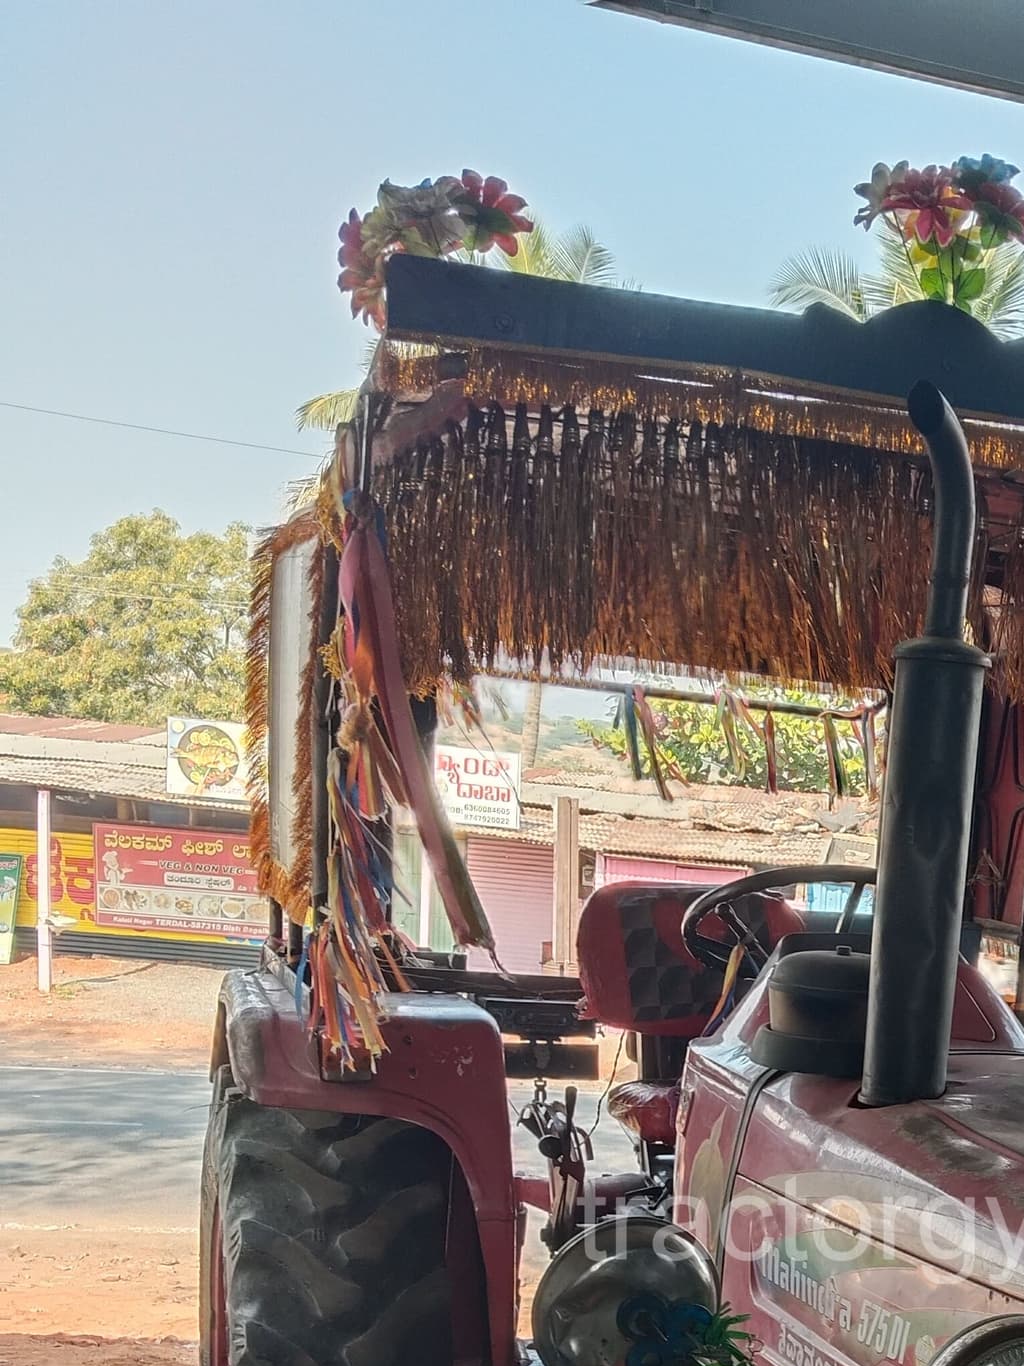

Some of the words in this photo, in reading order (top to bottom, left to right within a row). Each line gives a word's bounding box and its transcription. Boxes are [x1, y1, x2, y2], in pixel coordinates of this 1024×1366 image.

[158, 860, 182, 870] VEG
[184, 863, 192, 871] &
[195, 863, 219, 873] NON
[222, 865, 245, 875] VEG
[761, 1238, 852, 1332] Mahindra
[857, 1299, 891, 1354] 575
